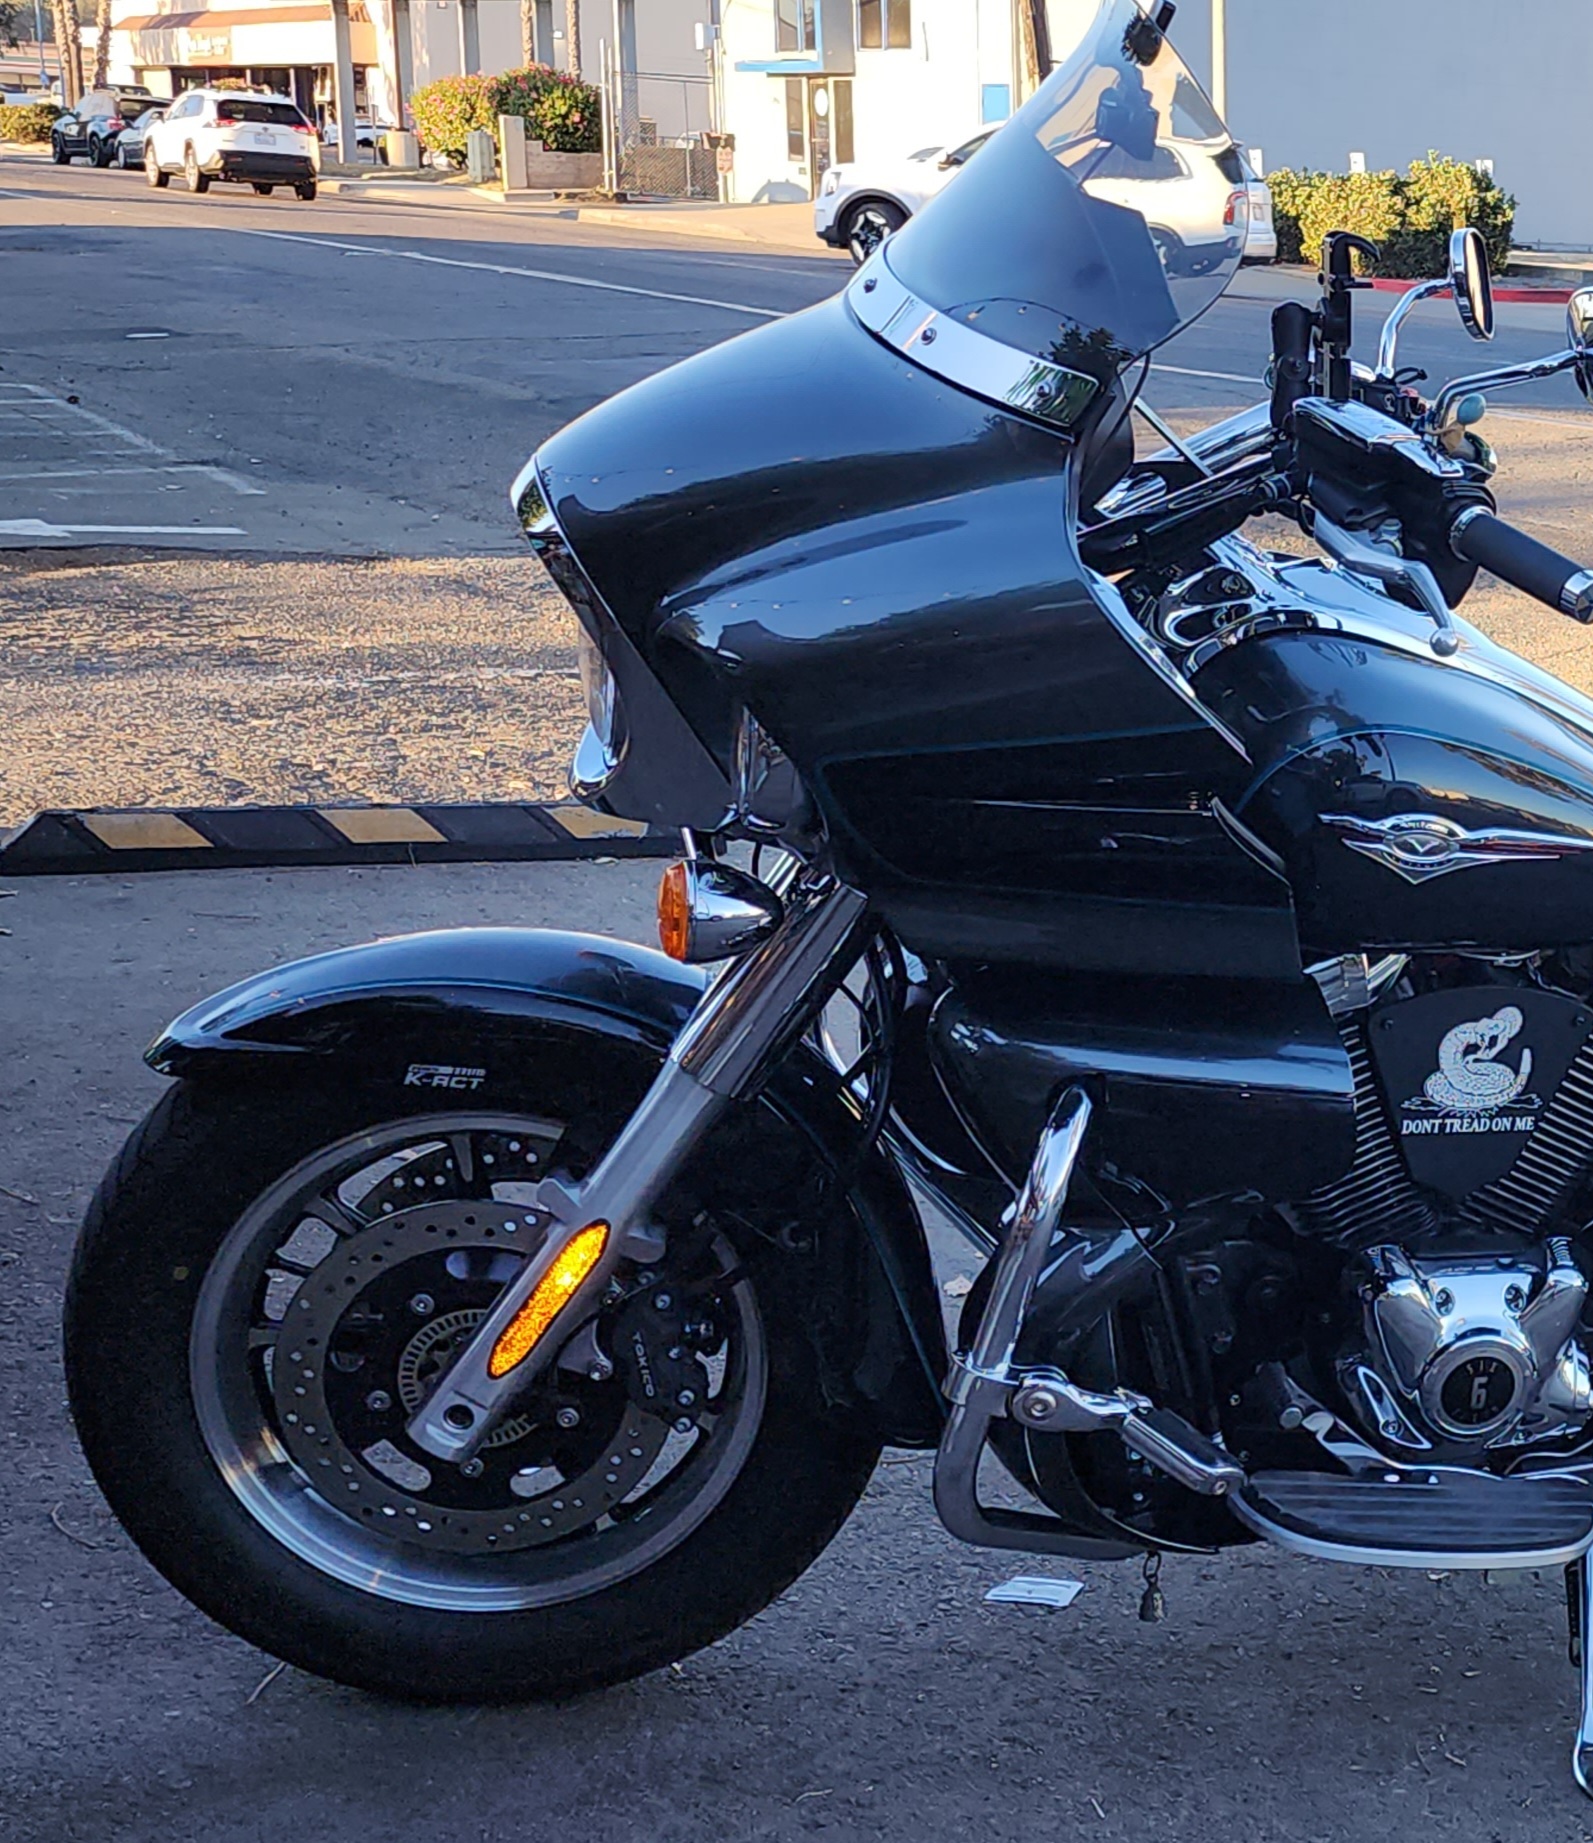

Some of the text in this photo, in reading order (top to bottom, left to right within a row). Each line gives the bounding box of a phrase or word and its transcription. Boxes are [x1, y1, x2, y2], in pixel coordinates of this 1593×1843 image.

[403, 1071, 485, 1090] K-ACT
[1402, 1116, 1536, 1134] DONT TREAD ON ME
[631, 1330, 655, 1398] TOKICO
[1470, 1376, 1489, 1409] 6
